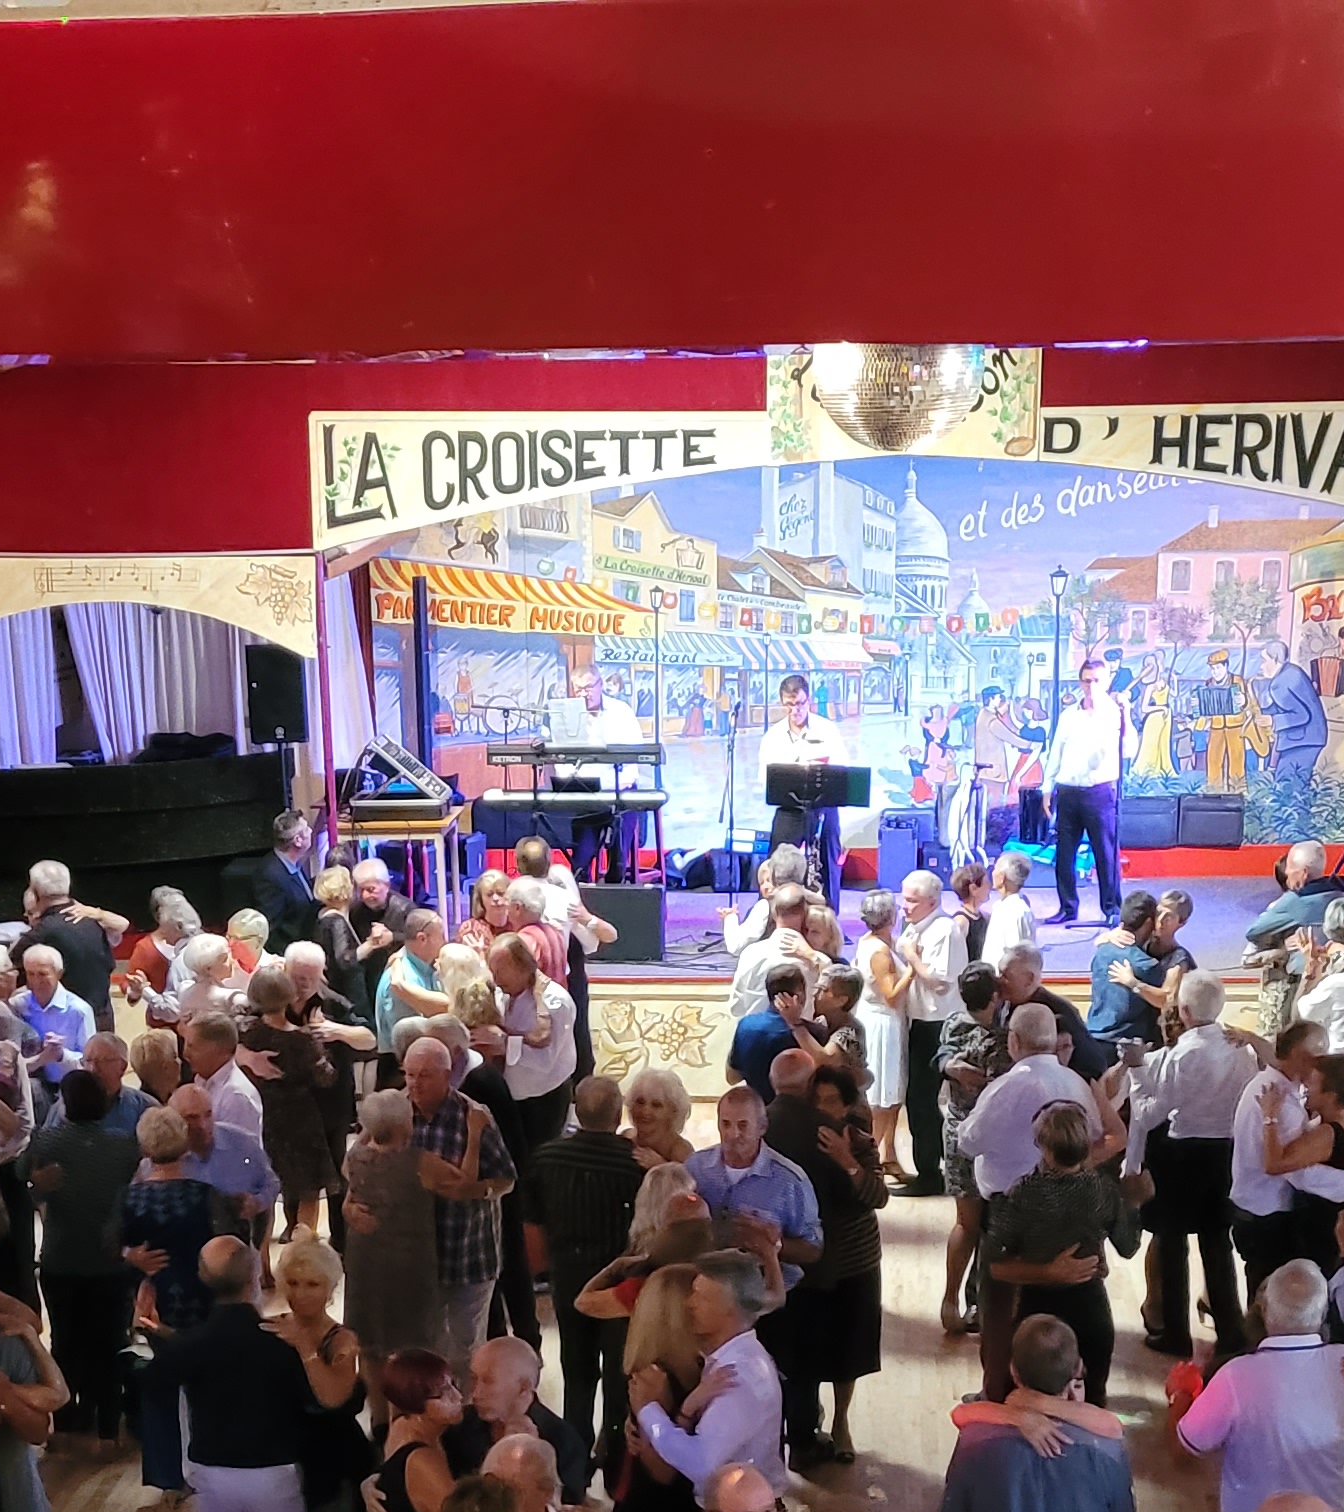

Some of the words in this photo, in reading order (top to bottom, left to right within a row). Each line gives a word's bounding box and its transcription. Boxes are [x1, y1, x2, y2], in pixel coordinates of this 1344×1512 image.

[323, 423, 398, 529] LA
[421, 428, 717, 511] CROISETTE
[959, 500, 988, 541] et
[1000, 492, 1045, 529] des
[1056, 472, 1204, 516] danseu
[604, 556, 619, 569] La
[620, 559, 665, 578] Croisette
[529, 606, 626, 636] MUSIQUE
